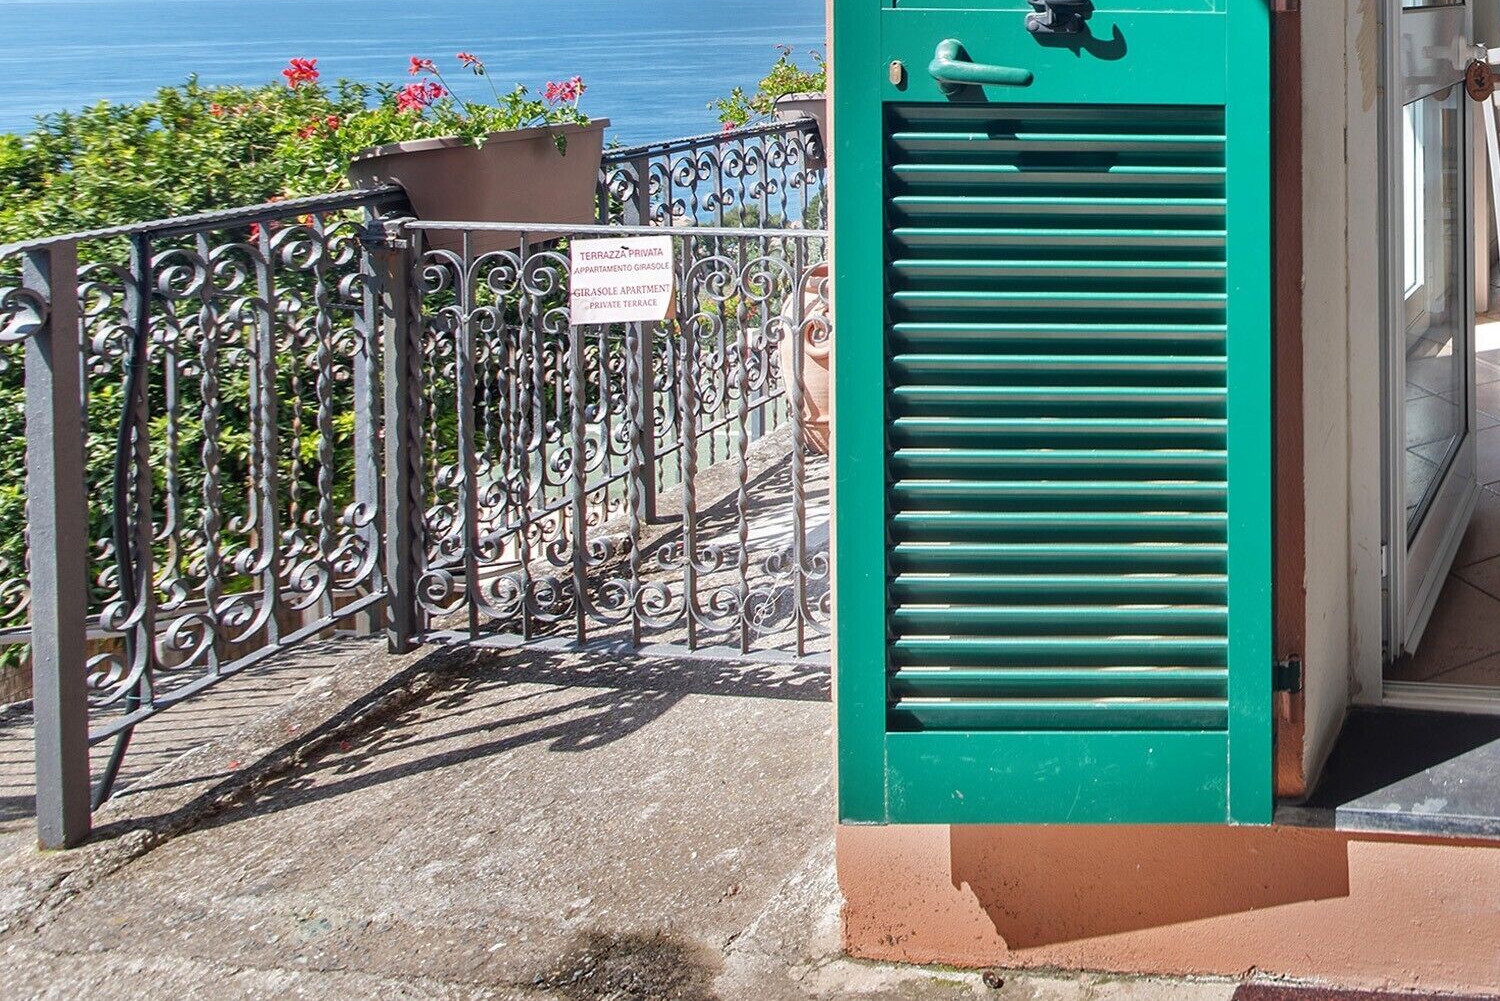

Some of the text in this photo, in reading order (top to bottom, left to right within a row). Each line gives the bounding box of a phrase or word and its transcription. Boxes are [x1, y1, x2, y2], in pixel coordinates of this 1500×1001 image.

[579, 247, 664, 261] TERRAZZA PRIVATA
[573, 262, 670, 275] APPARTAMENTO GIRASOLE
[573, 284, 670, 298] GIRASOLE APARTMENT
[589, 299, 658, 310] PRIVATE TERRACE
